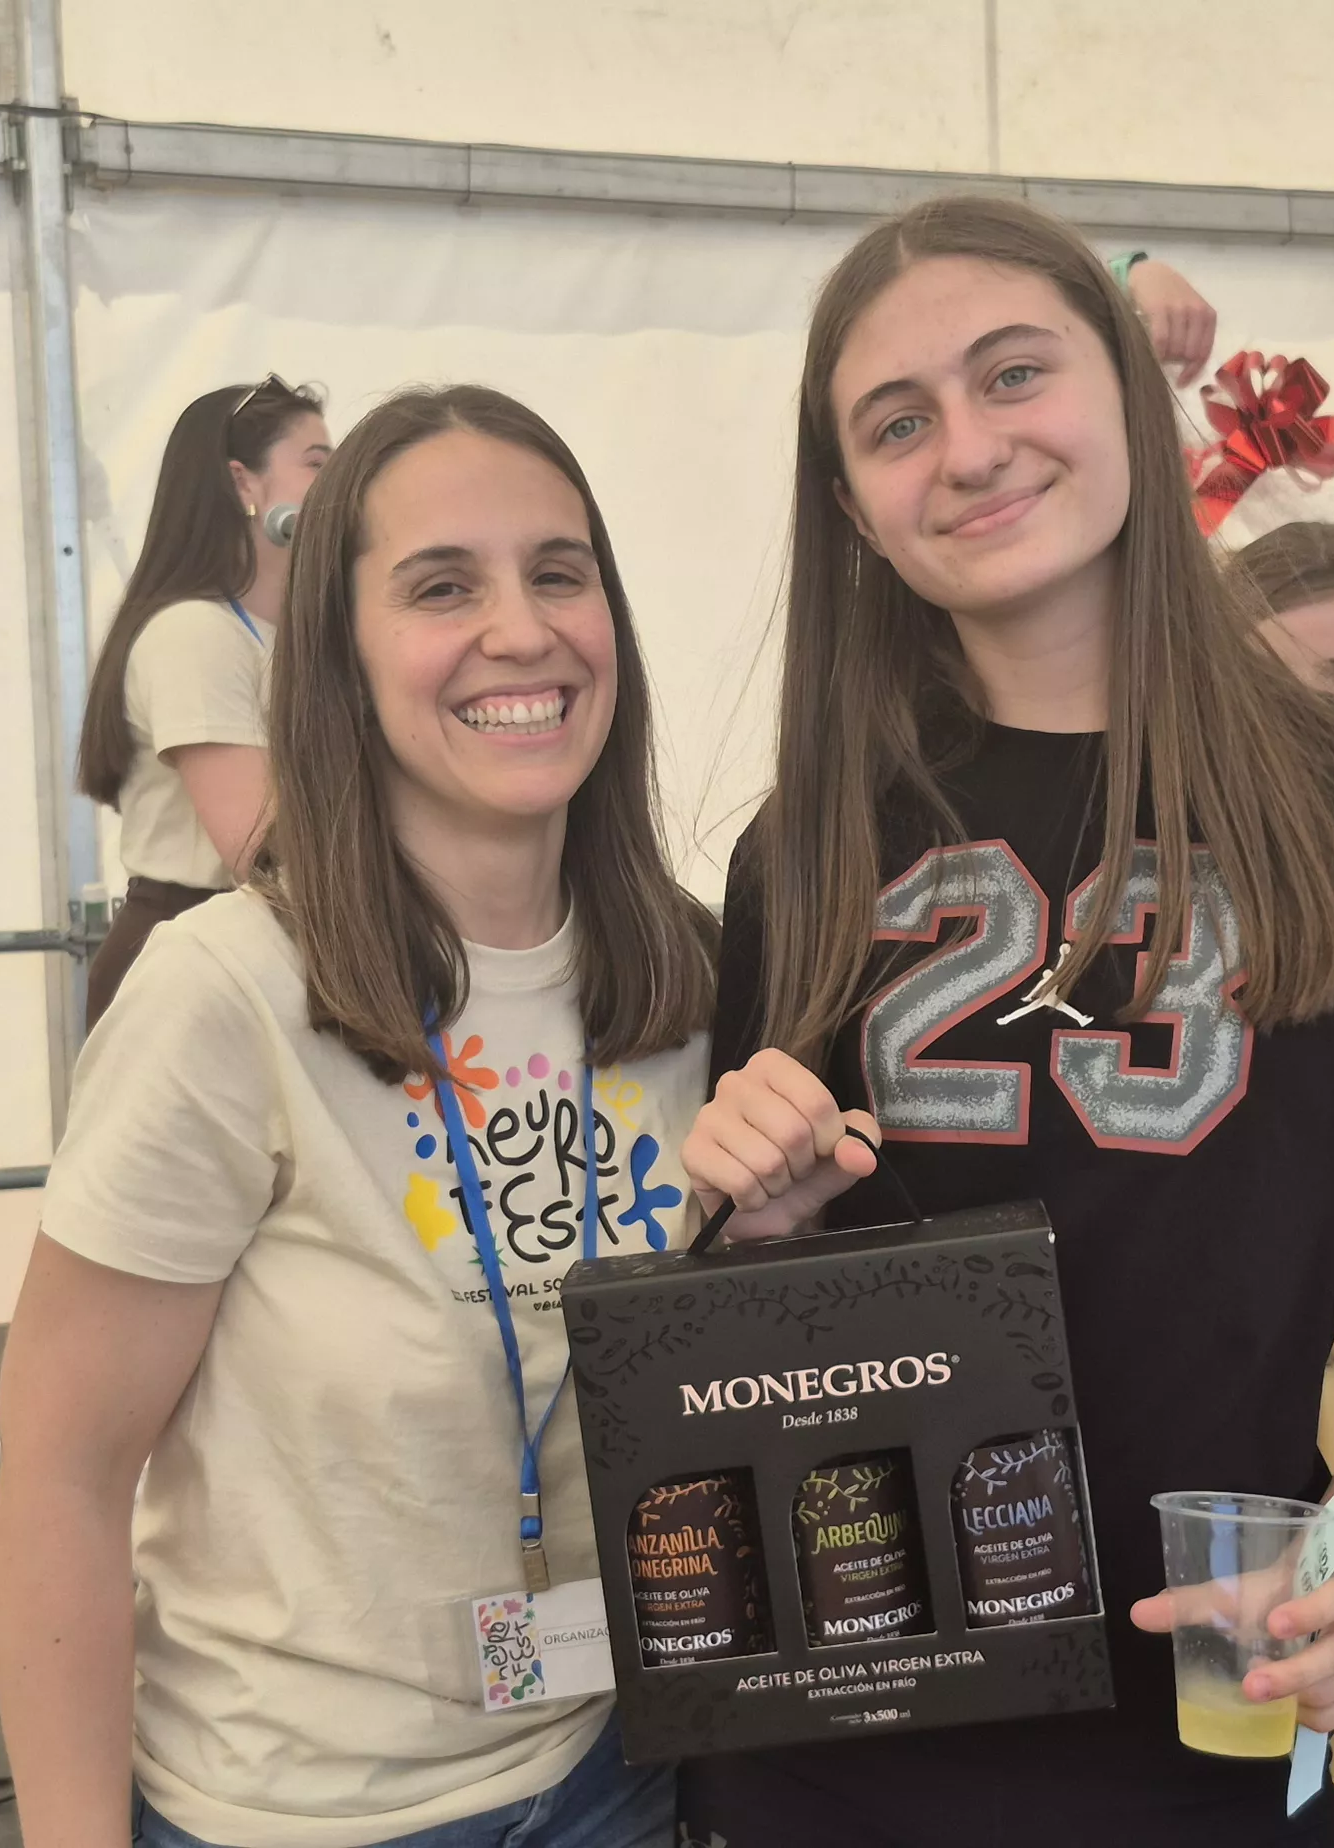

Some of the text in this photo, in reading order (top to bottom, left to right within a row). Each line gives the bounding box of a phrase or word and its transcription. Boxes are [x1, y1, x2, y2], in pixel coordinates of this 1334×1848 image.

[861, 838, 1255, 1156] 23
[464, 1283, 539, 1303] FESTVAL
[782, 1407, 858, 1429] Desde 1838
[962, 1494, 1054, 1535] LECCIANA
[628, 1525, 724, 1556] ANZANILLA
[811, 1510, 907, 1554] ARBEQUIN
[974, 1532, 1053, 1554] ACEITE DE OLIVA
[632, 1553, 718, 1578] ONEGRINA
[833, 1559, 868, 1572] ACEITE
[870, 1556, 882, 1567] DE
[981, 1545, 1050, 1564] VIRGEN EXTRA
[841, 1569, 878, 1582] VIRGEN
[665, 1591, 677, 1600] DE
[679, 1586, 711, 1599] OLIVA
[968, 1582, 1075, 1616] MONEGROS
[675, 1600, 706, 1611] EXTRA
[641, 1628, 733, 1652] ONEGROS
[736, 1650, 985, 1692] ACEITE DE OLIVA VIRGEN EXTRA
[808, 1676, 917, 1699] EXTRACCIÓN EN FRÍO
[863, 1708, 898, 1723] 3x500
